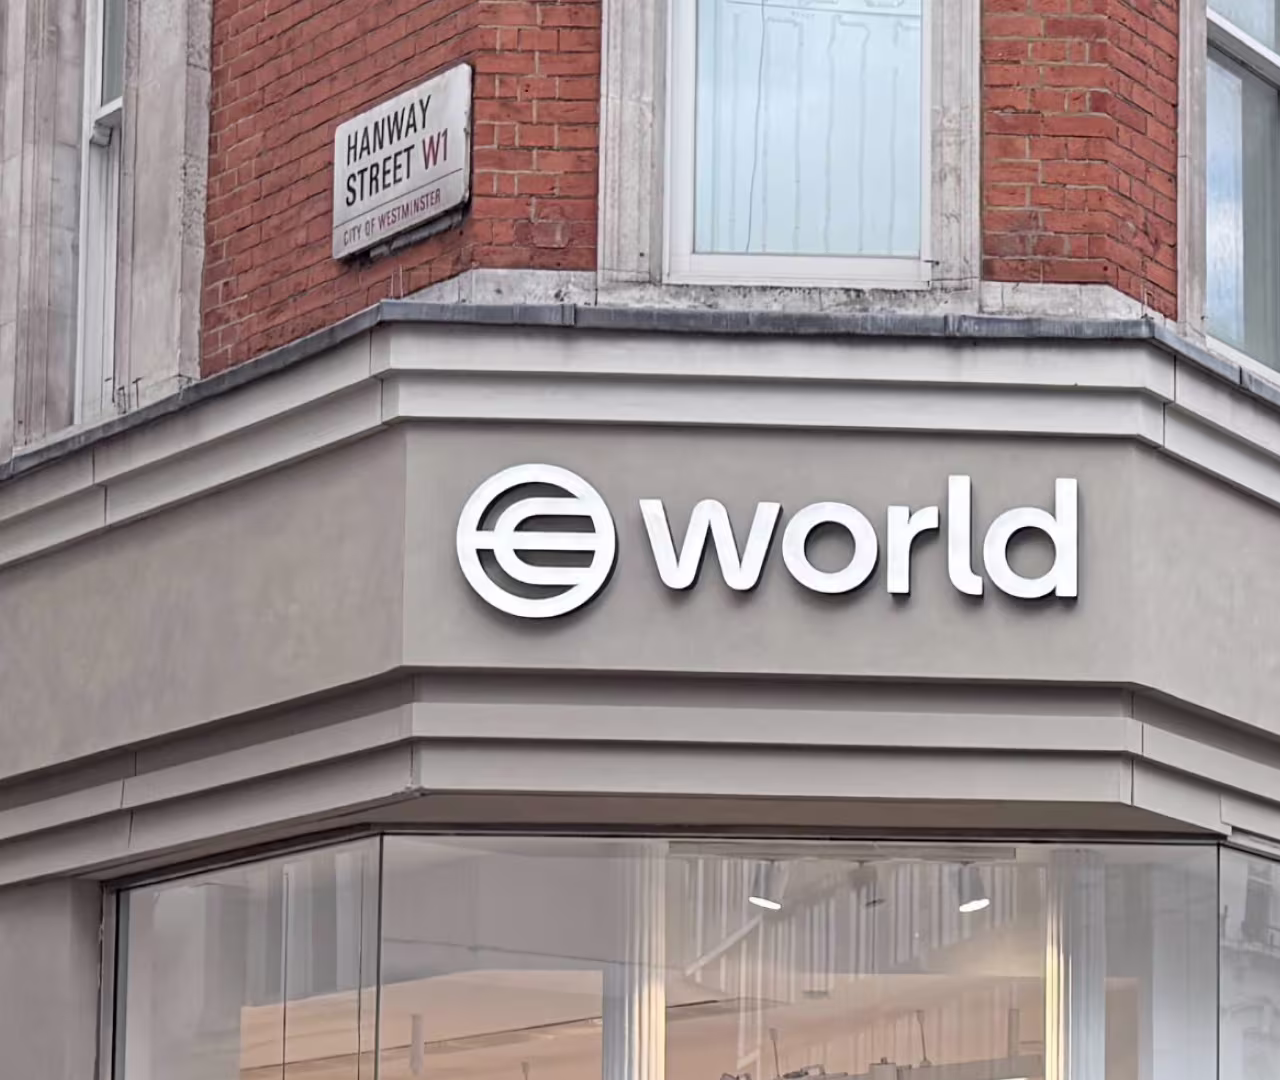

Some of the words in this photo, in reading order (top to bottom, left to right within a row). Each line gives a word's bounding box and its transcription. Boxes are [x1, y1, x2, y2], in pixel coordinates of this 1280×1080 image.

[346, 145, 415, 207] STREET
[422, 128, 448, 170] W1
[347, 95, 431, 166] HANWAY
[343, 226, 362, 246] CITY
[365, 219, 377, 235] OF
[378, 188, 441, 230] WESTMINSTER
[639, 475, 1078, 599] world
